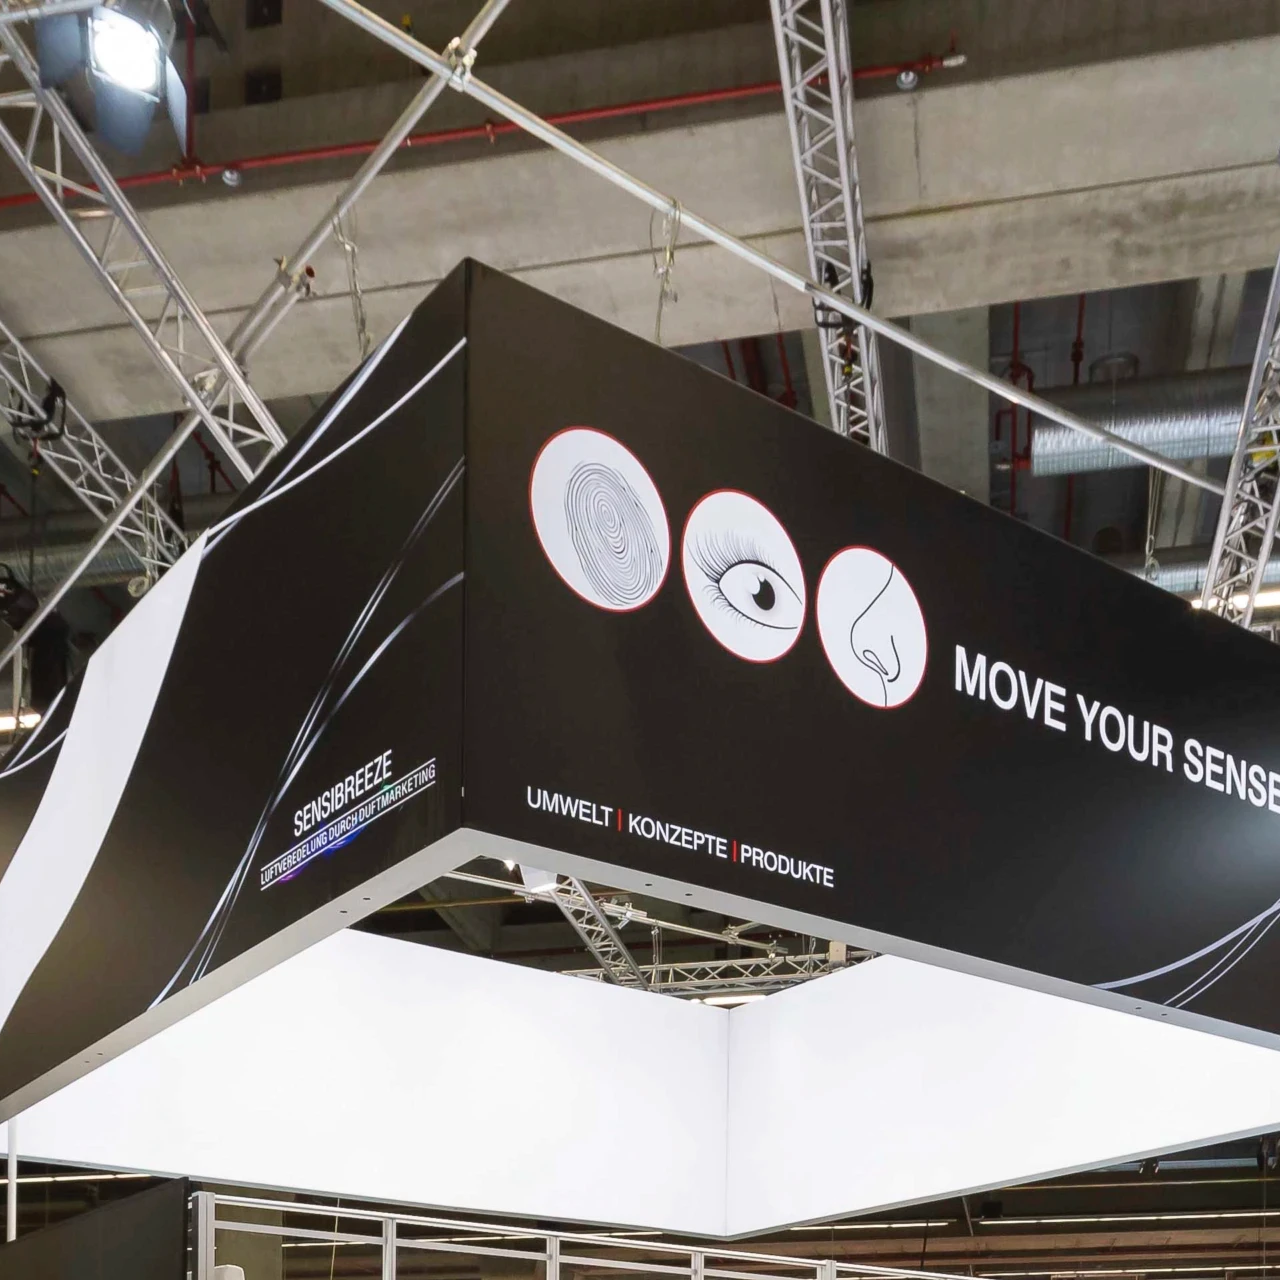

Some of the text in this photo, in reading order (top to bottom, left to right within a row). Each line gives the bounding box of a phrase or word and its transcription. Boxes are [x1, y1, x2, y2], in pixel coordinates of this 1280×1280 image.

[955, 644, 1066, 732] MOVE
[1076, 693, 1173, 772] YOUR
[260, 763, 436, 885] LUFTVEREDELUNG DURCH DUFTMARKETING
[294, 749, 392, 837] SENSIBREEZE
[527, 785, 835, 888] UMWELT KONZEPTE PRODUKTE
